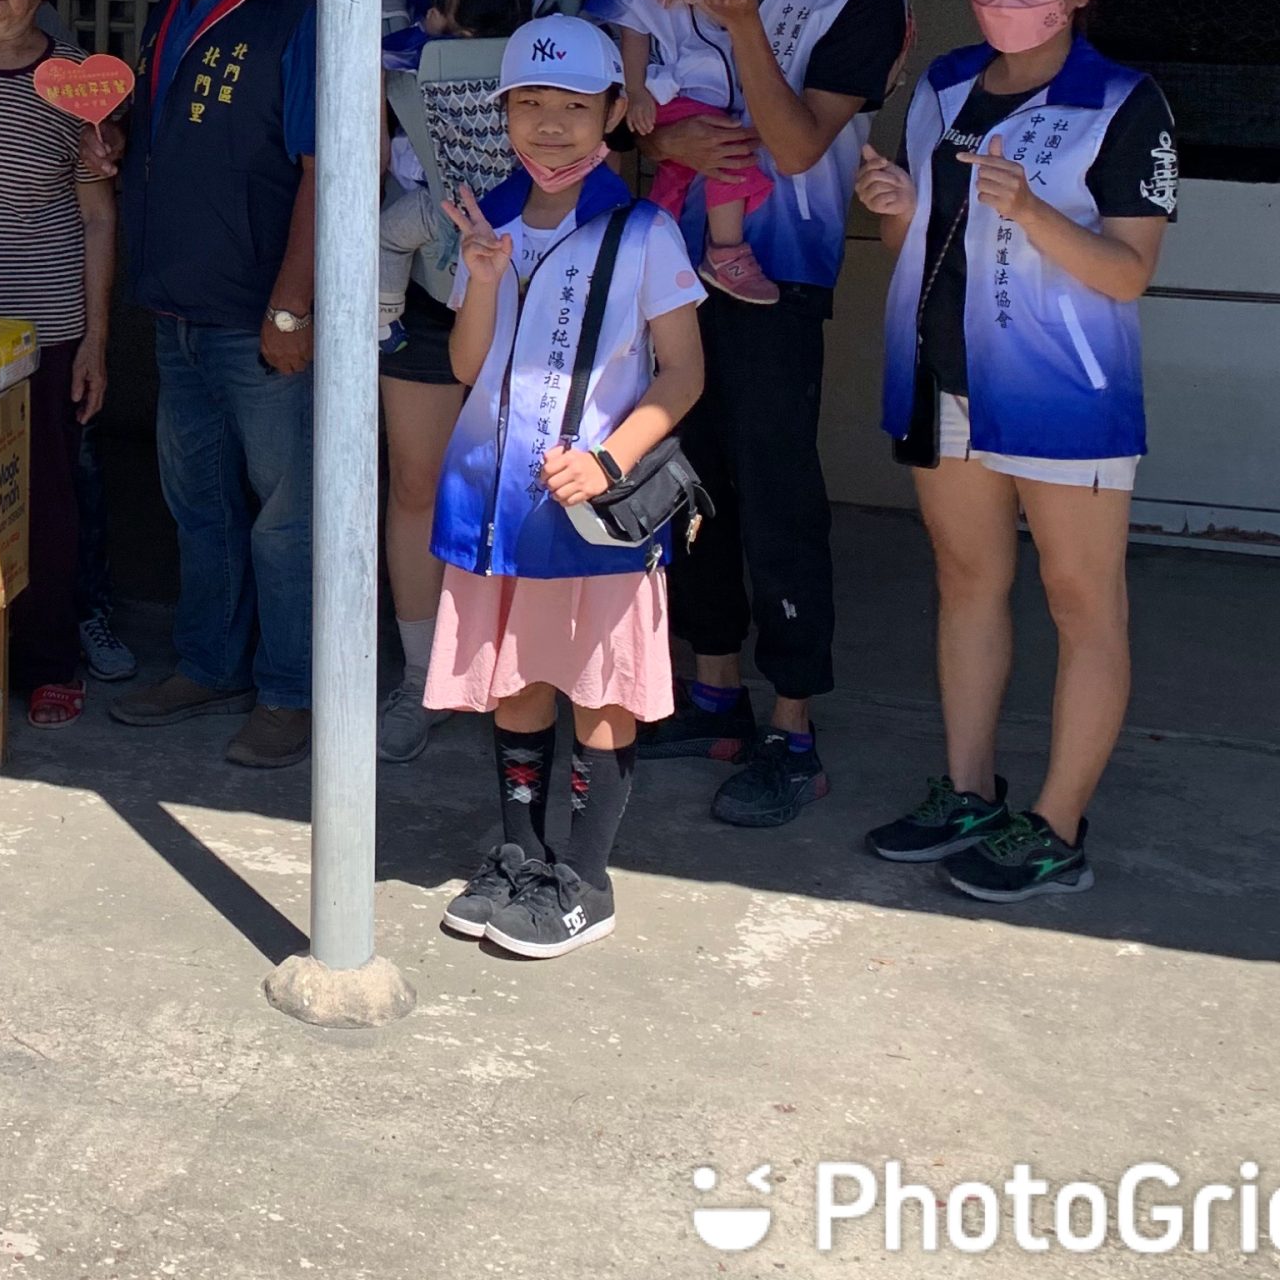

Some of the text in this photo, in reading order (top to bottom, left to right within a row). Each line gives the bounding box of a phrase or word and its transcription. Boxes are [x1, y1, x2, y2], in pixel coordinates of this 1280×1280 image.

[218, 42, 249, 104] 北門區
[532, 37, 556, 62] NY
[188, 46, 221, 124] 北門里
[1028, 118, 1069, 186] 社團法人
